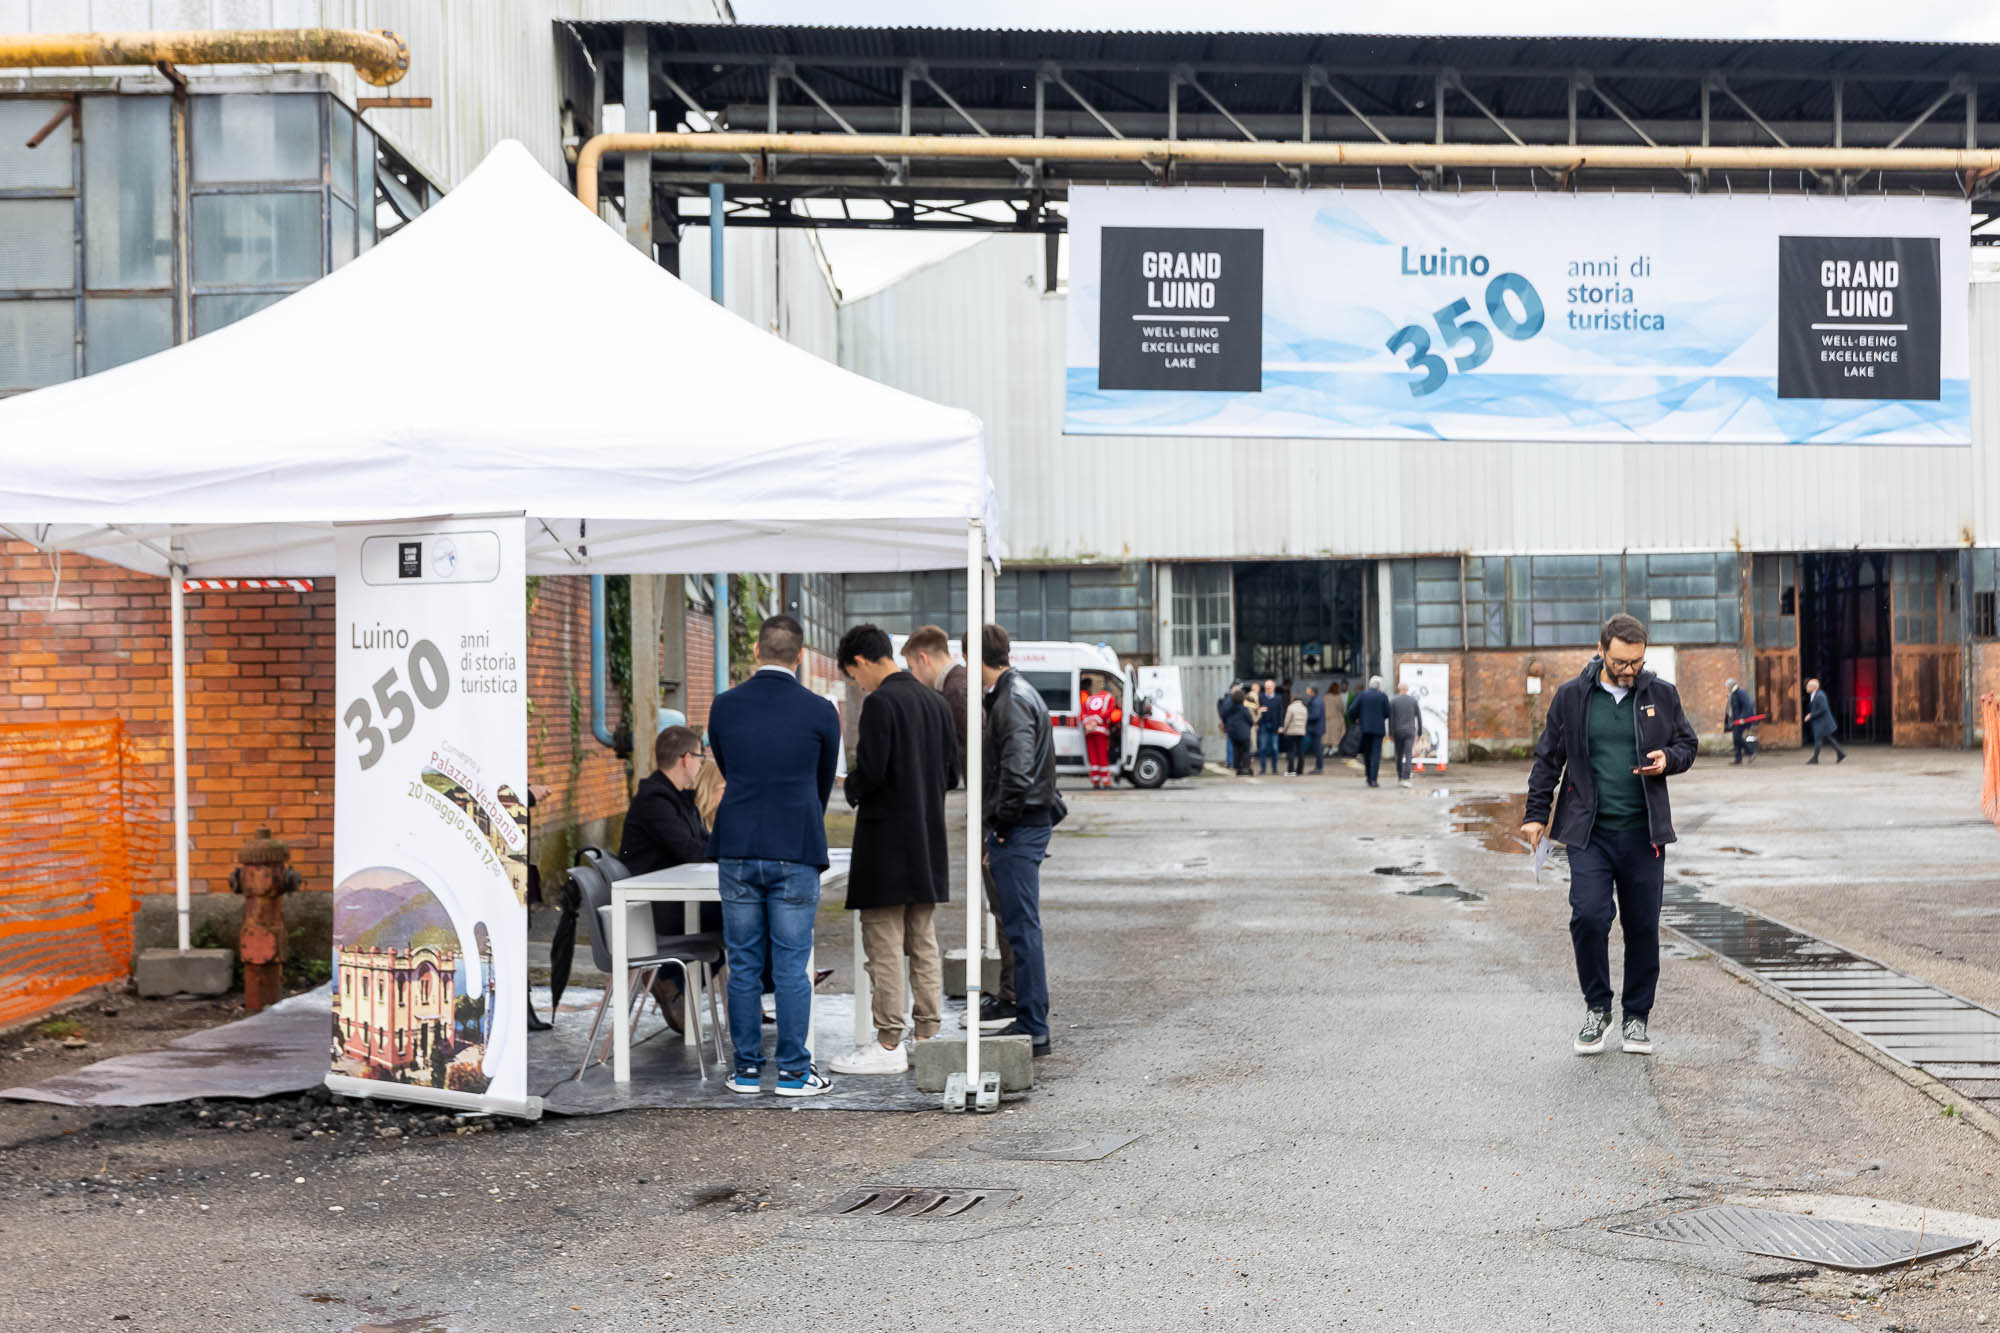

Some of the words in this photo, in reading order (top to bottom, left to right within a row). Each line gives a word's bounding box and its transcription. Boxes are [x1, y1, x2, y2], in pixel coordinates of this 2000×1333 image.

[1142, 251, 1222, 280] GRAND
[1401, 246, 1490, 277] Luino
[1568, 256, 1618, 278] anni
[1630, 256, 1651, 278] di
[1820, 260, 1899, 289] GRAND
[1147, 281, 1216, 309] LUINO
[1567, 282, 1634, 304] storia
[1826, 289, 1894, 318] LUINO
[1568, 308, 1665, 331] turistica
[1142, 327, 1219, 339] WELL-BEING
[1386, 272, 1545, 397] 350
[1821, 335, 1897, 347] WELL-BEING
[1141, 342, 1220, 354] EXCELLENCE
[1820, 350, 1898, 363] EXCELLENCE
[1164, 357, 1197, 369] LAKE
[1843, 366, 1875, 378] LAKE
[351, 622, 409, 650] Luino
[460, 630, 489, 649] anni
[460, 652, 472, 671] di
[475, 652, 516, 671] storia
[461, 675, 518, 694] turistica
[343, 639, 450, 771] 350
[430, 751, 473, 791] Palazzo
[475, 783, 519, 845] Verbania
[407, 781, 423, 799] 20
[425, 793, 465, 830] maggio
[465, 829, 482, 851] ore
